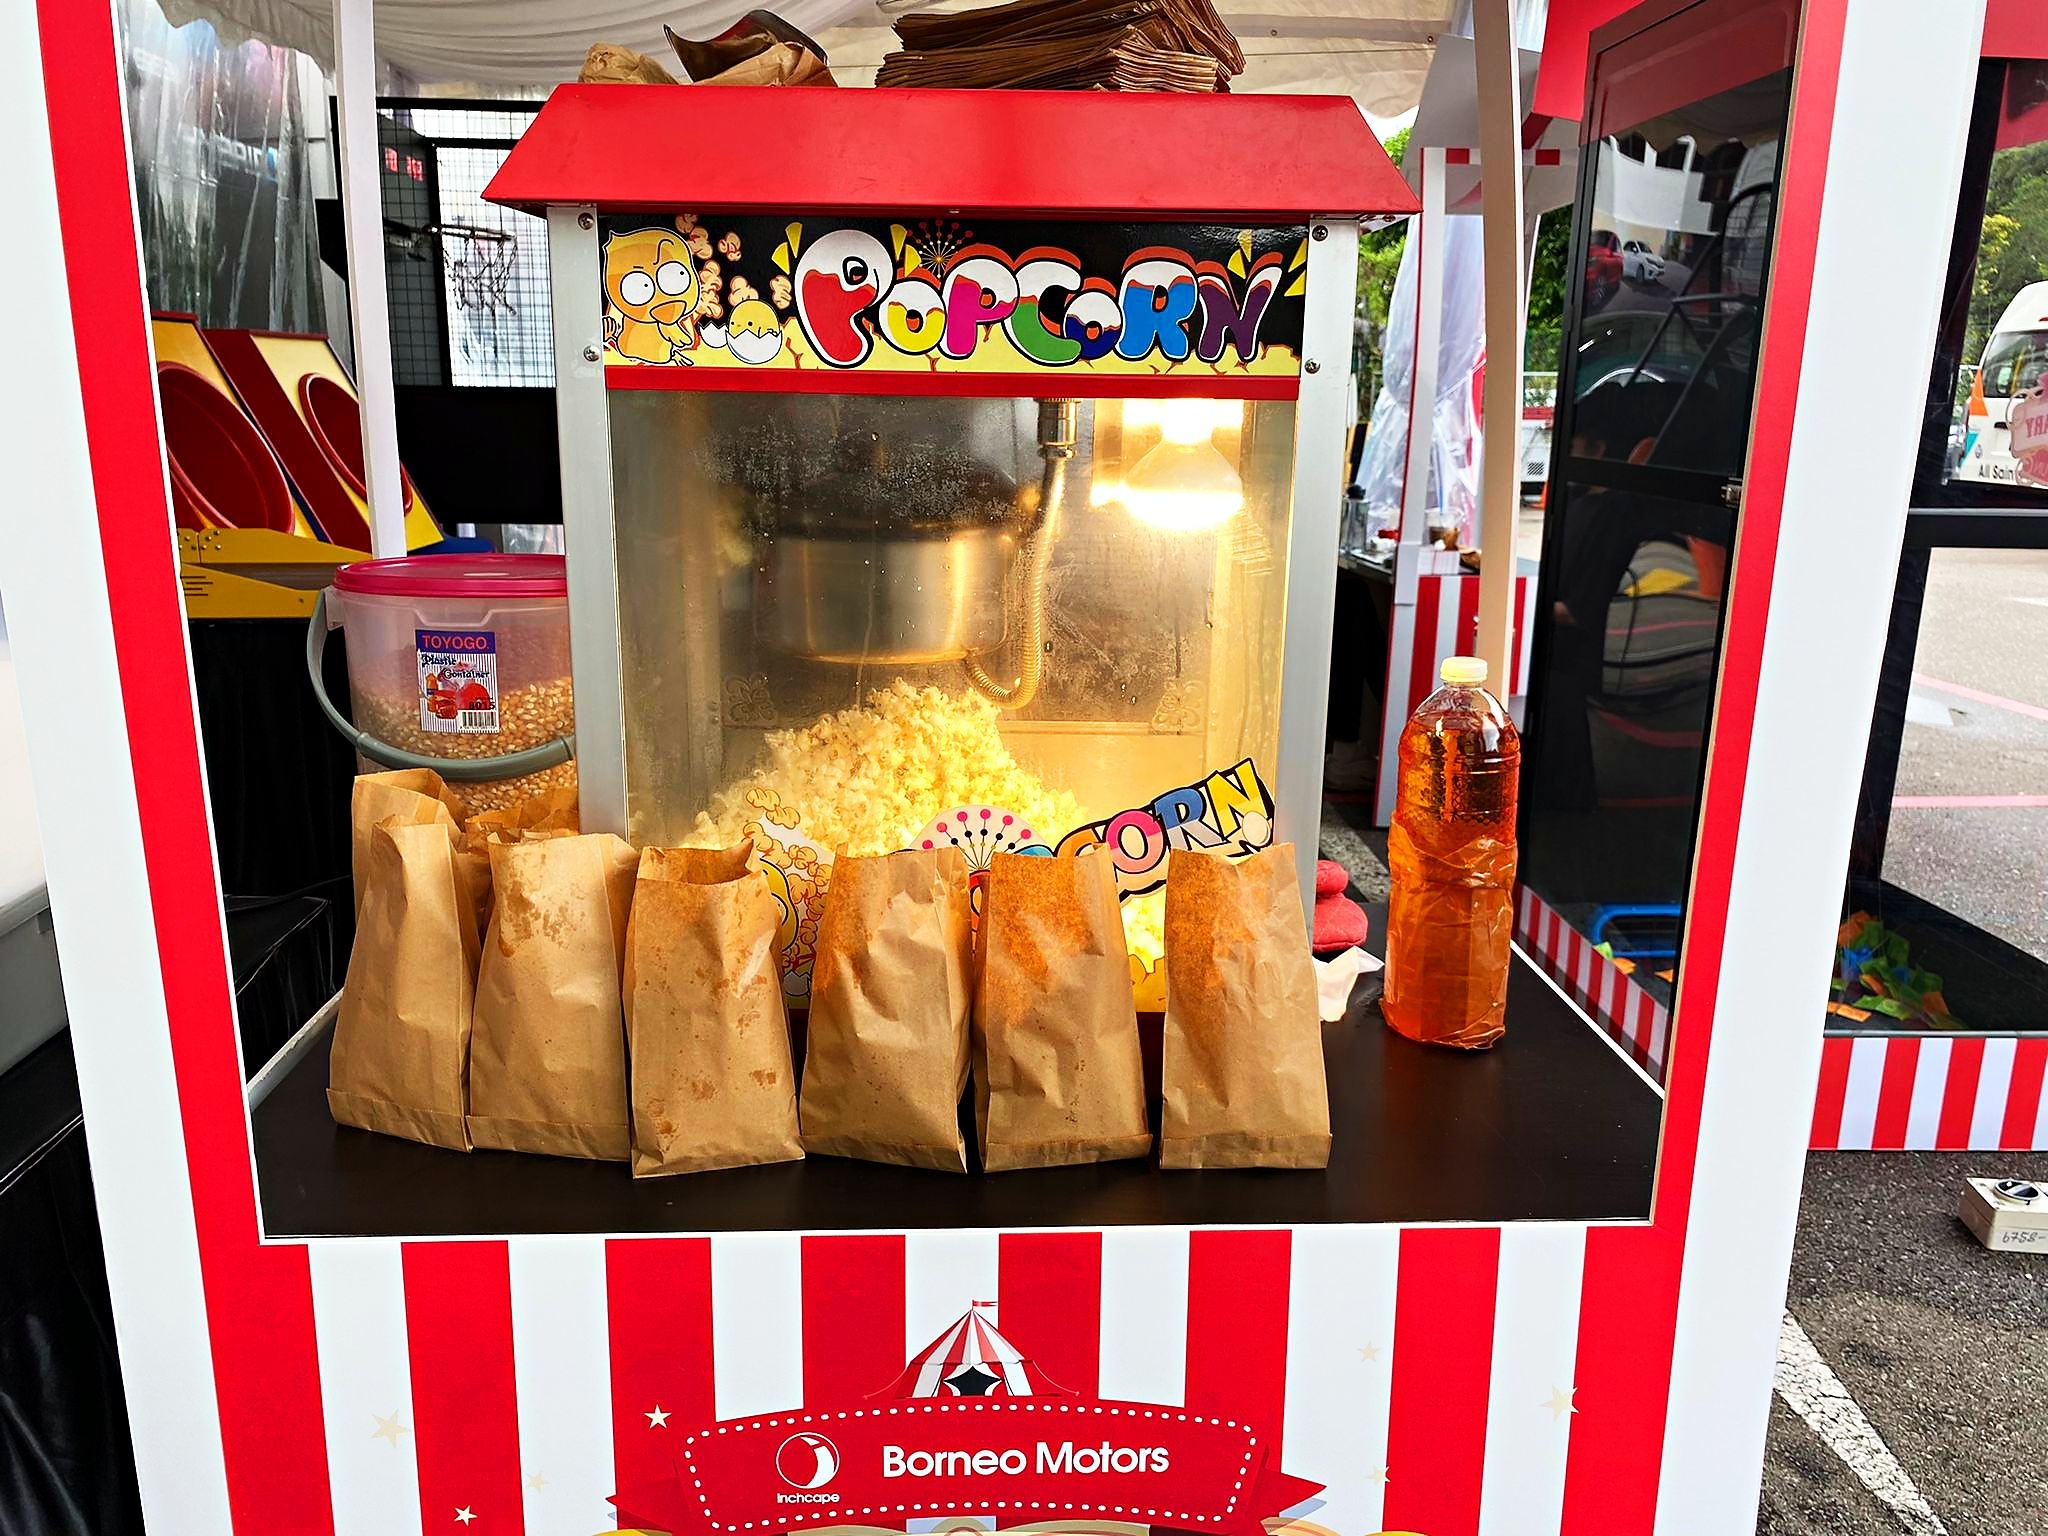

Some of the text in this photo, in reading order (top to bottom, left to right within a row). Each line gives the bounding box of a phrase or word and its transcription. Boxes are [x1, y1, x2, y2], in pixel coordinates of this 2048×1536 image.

[794, 229, 1284, 368] POPCORN
[1979, 464, 2014, 480] All Sain
[422, 635, 488, 649] TOYOGO
[421, 654, 457, 667] Plastic
[443, 668, 490, 679] Container
[882, 1441, 1170, 1477] Borneo Motors
